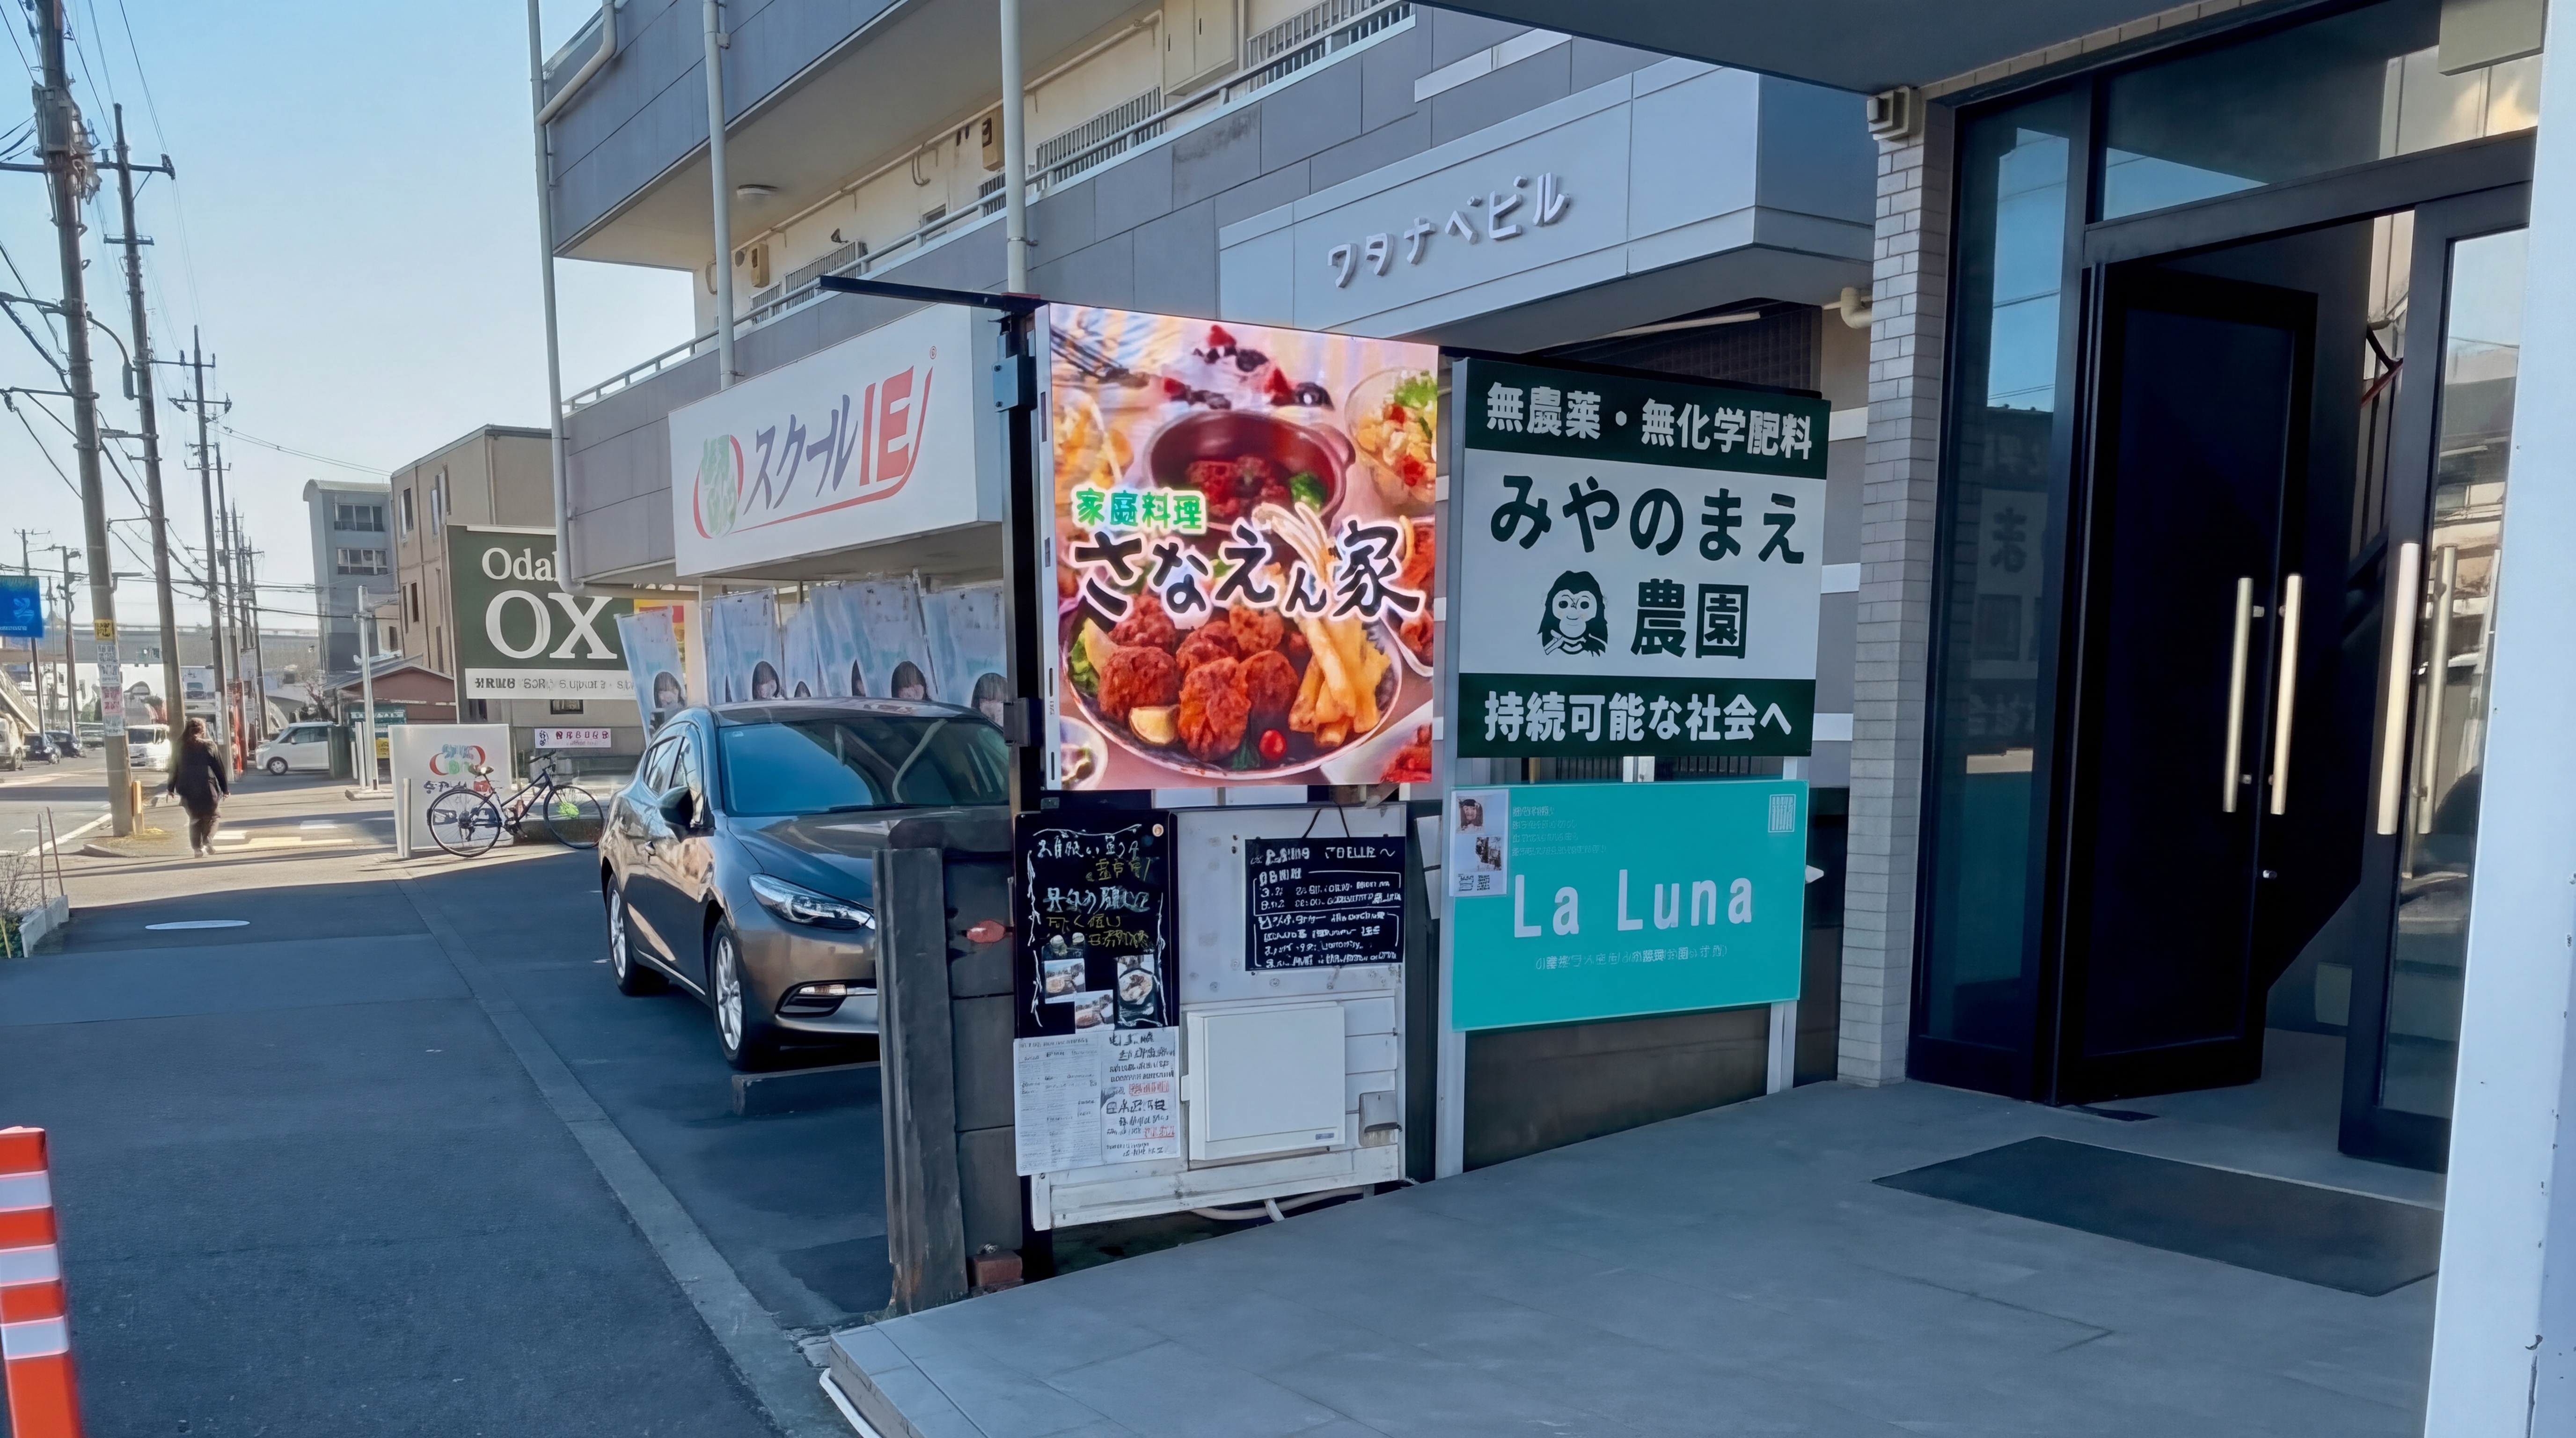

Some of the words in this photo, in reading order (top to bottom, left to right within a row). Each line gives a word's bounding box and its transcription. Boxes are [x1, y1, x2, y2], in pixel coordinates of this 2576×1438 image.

[1327, 172, 1570, 287] ワタナベビル
[1486, 382, 1812, 460] 無農薬・無化学肥料
[1491, 475, 1805, 564] みやのまえ
[1075, 520, 1422, 618] さなえん家
[485, 590, 618, 660] OX
[1631, 579, 1749, 659] 農園
[1485, 690, 1792, 741] 持続可能な社会へ
[1514, 874, 1579, 938] La
[1617, 869, 1752, 931] Luna
